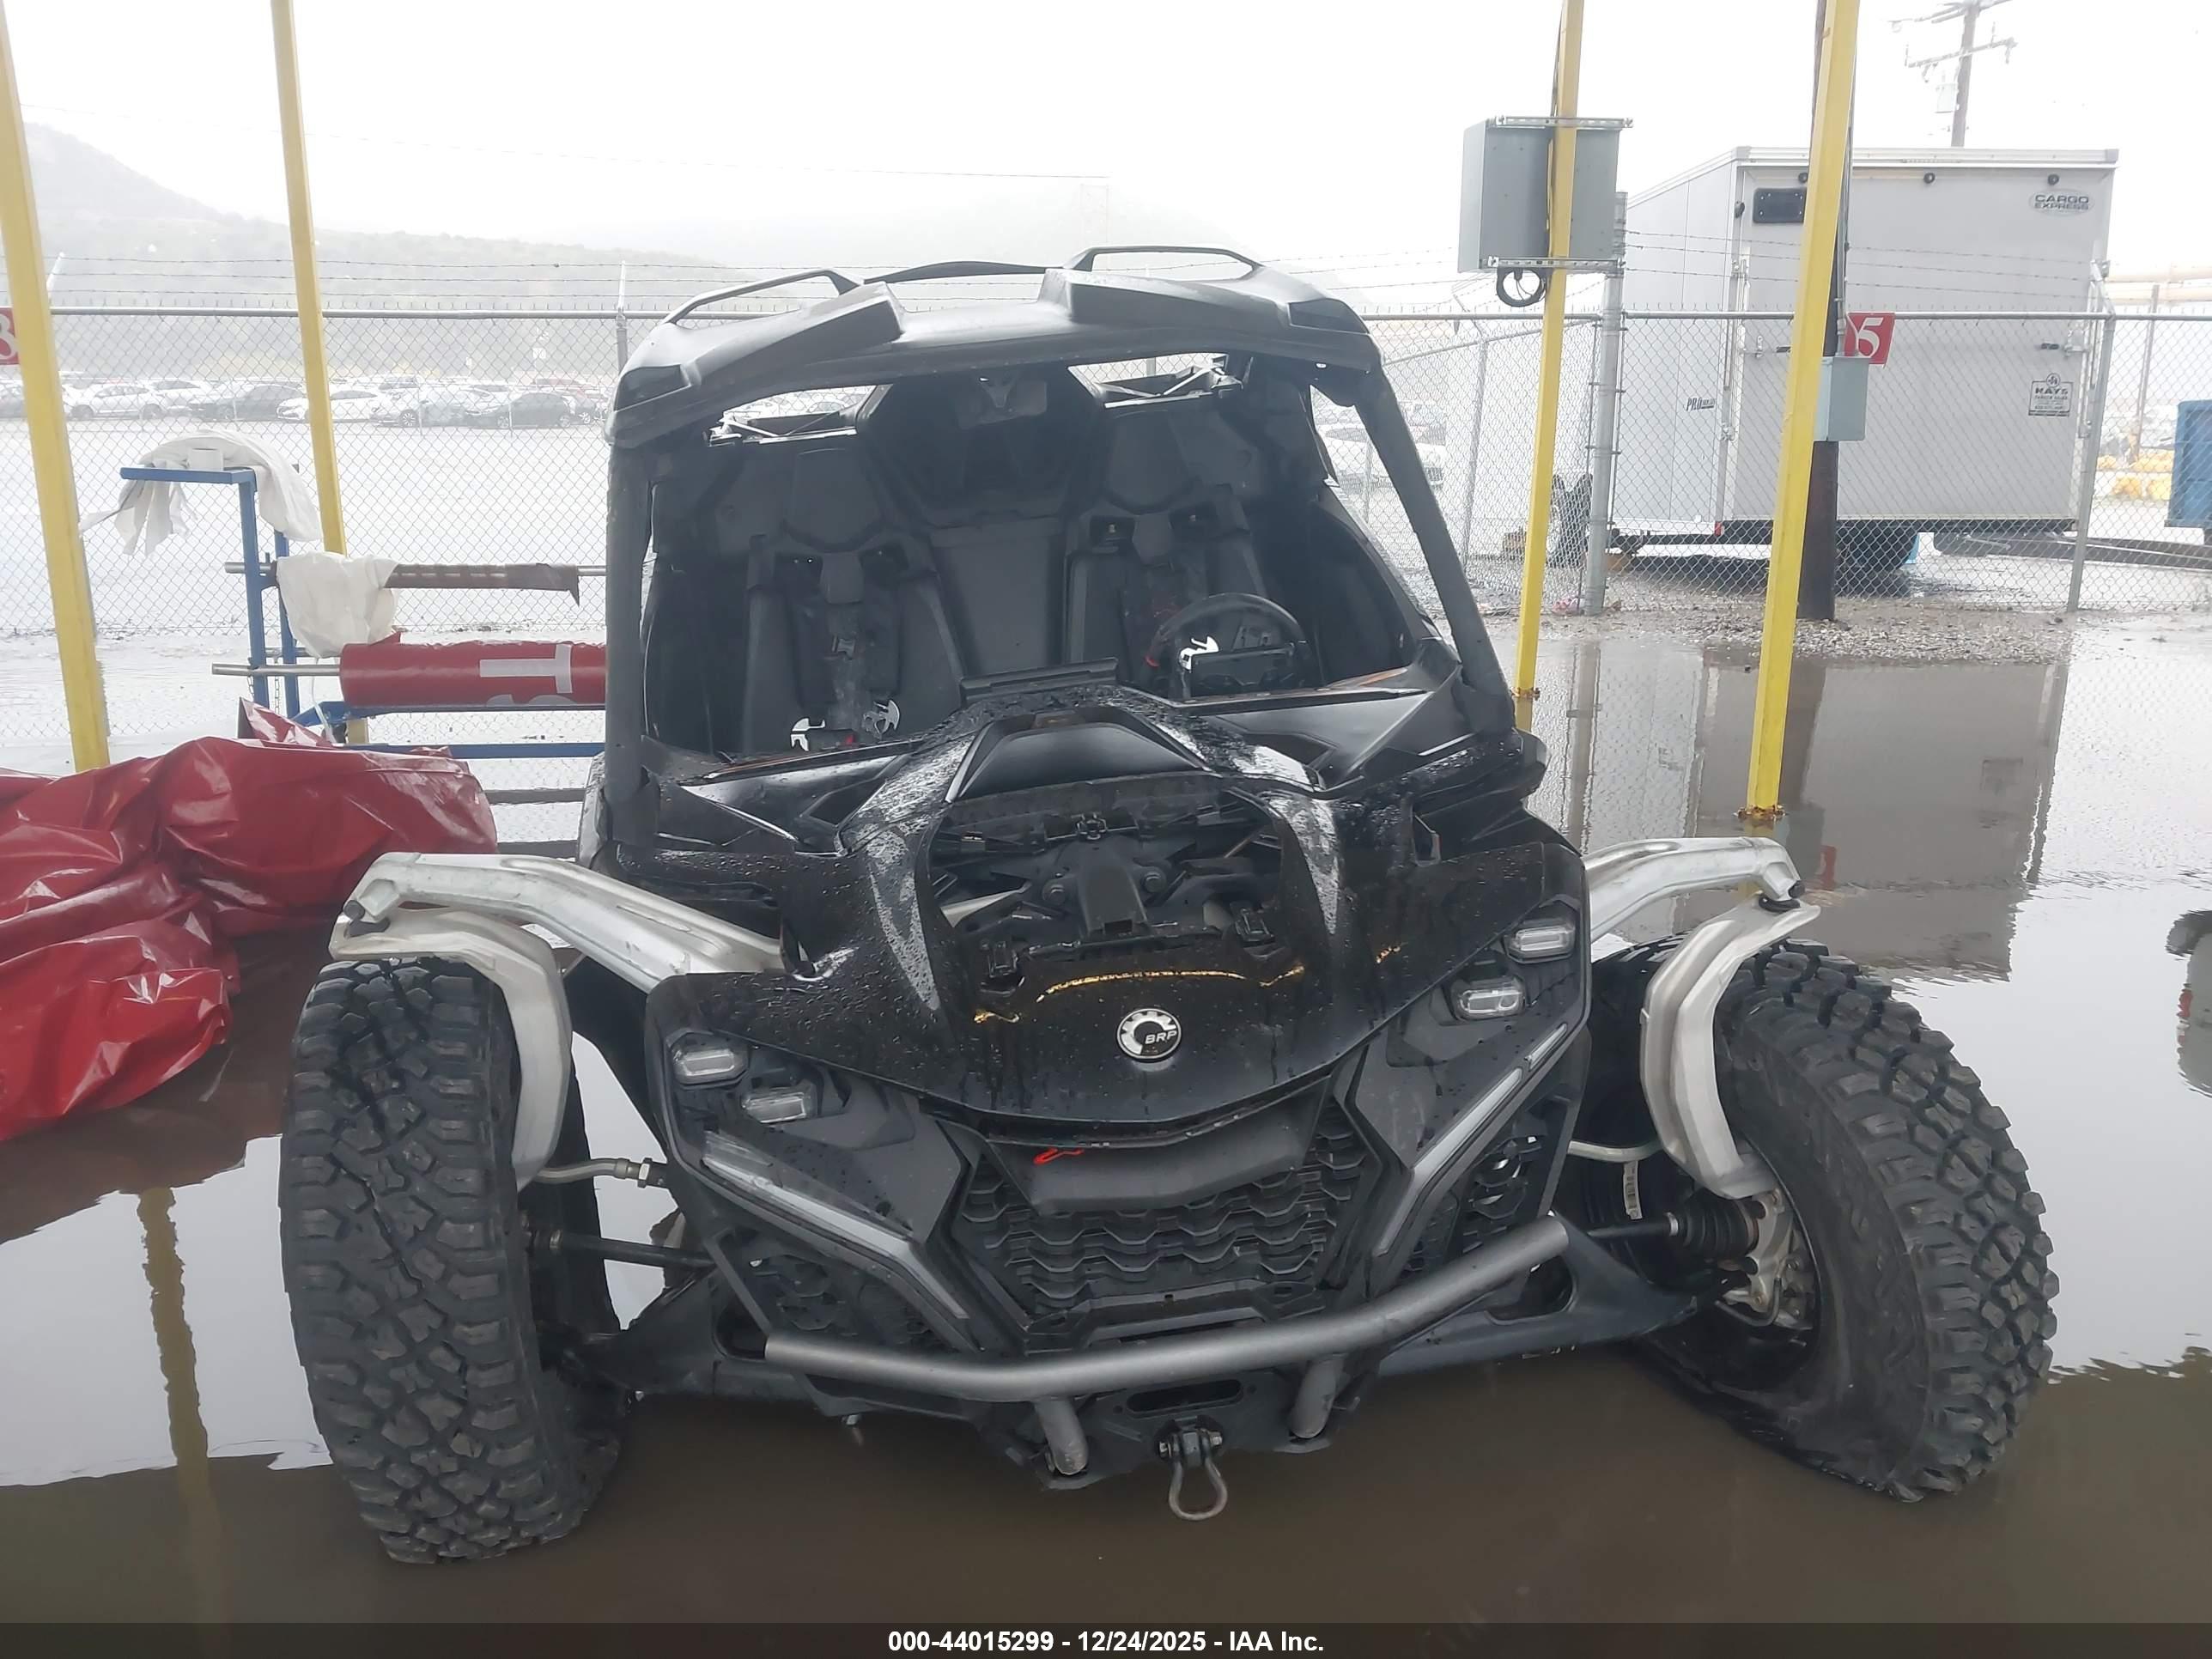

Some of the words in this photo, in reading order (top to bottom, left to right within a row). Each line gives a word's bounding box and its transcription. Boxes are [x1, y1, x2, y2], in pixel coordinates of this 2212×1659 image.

[2034, 194, 2089, 204] CARGO
[1856, 317, 1884, 358] 5
[1145, 1030, 1177, 1044] BRP
